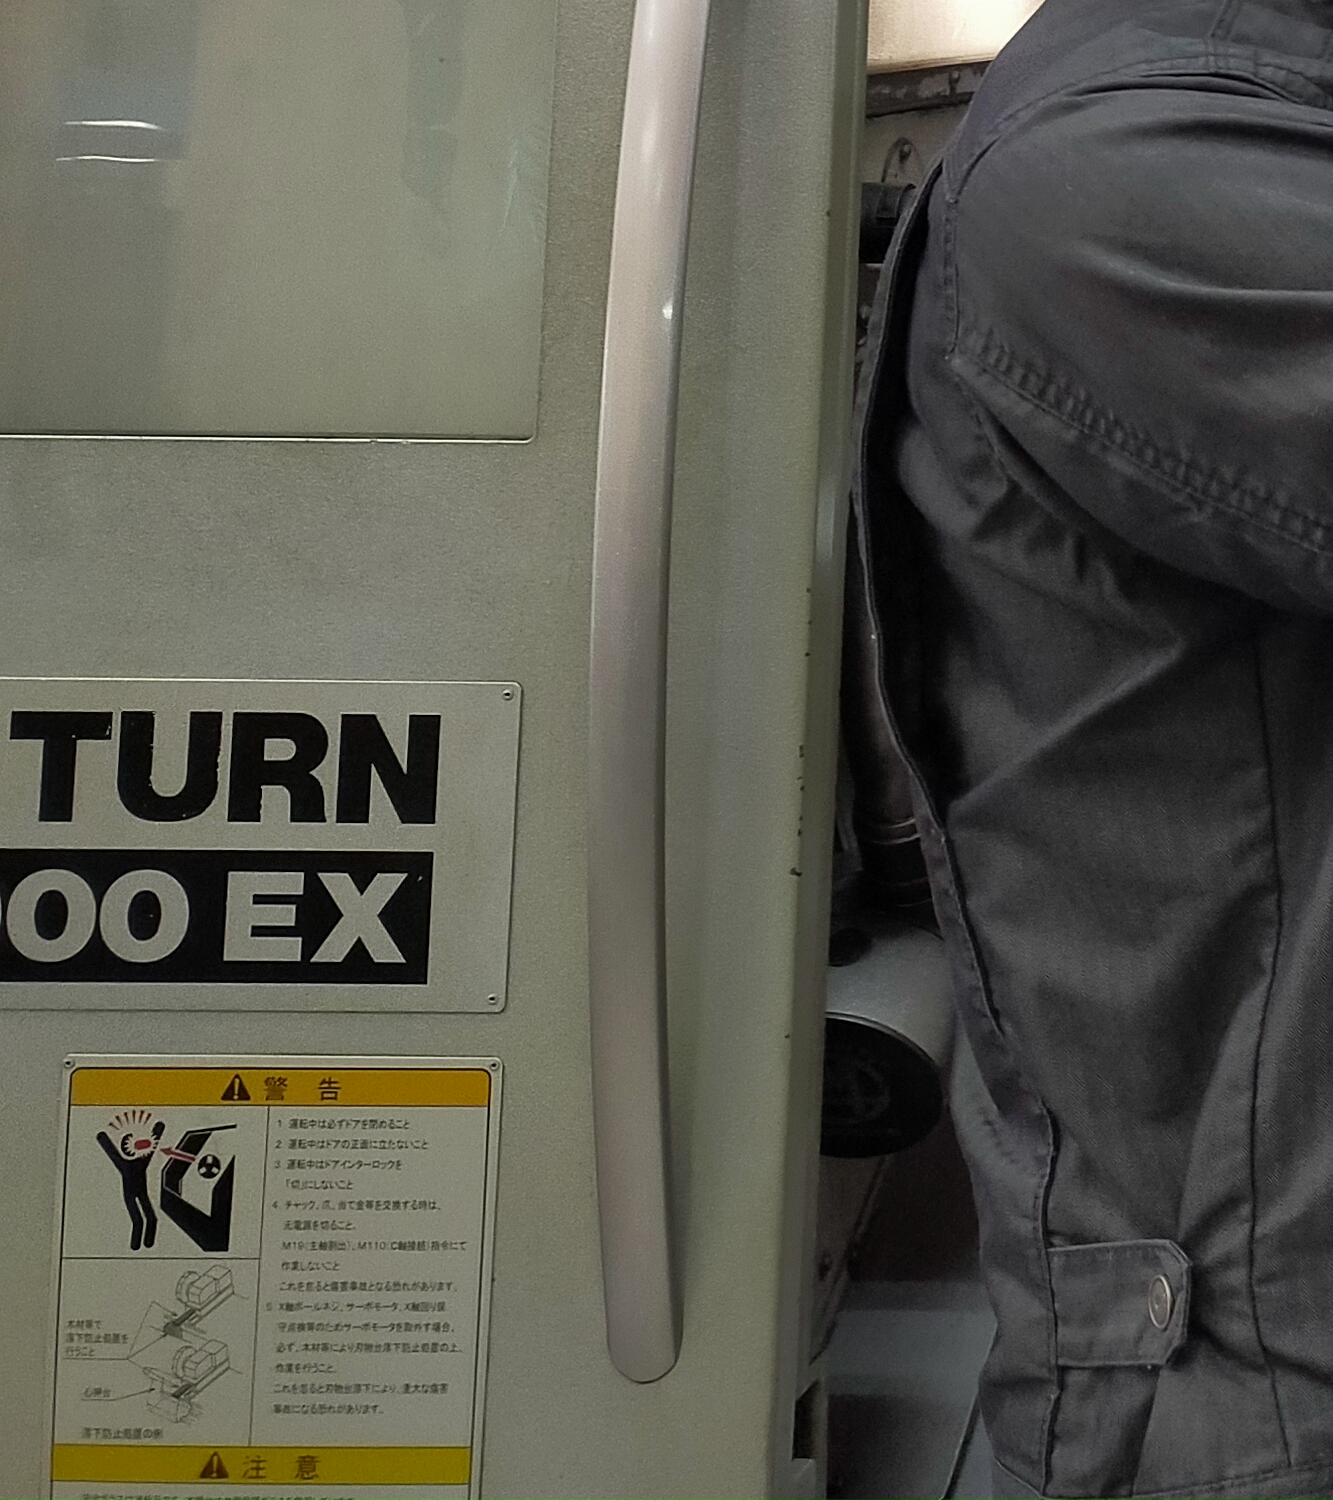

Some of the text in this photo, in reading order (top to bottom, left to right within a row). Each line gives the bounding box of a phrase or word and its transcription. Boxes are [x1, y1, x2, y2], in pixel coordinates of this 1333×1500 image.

[9, 710, 441, 824] TURN
[0, 868, 408, 963] 00 EX
[264, 1075, 342, 1102] 警告
[243, 1453, 321, 1480] 注意
